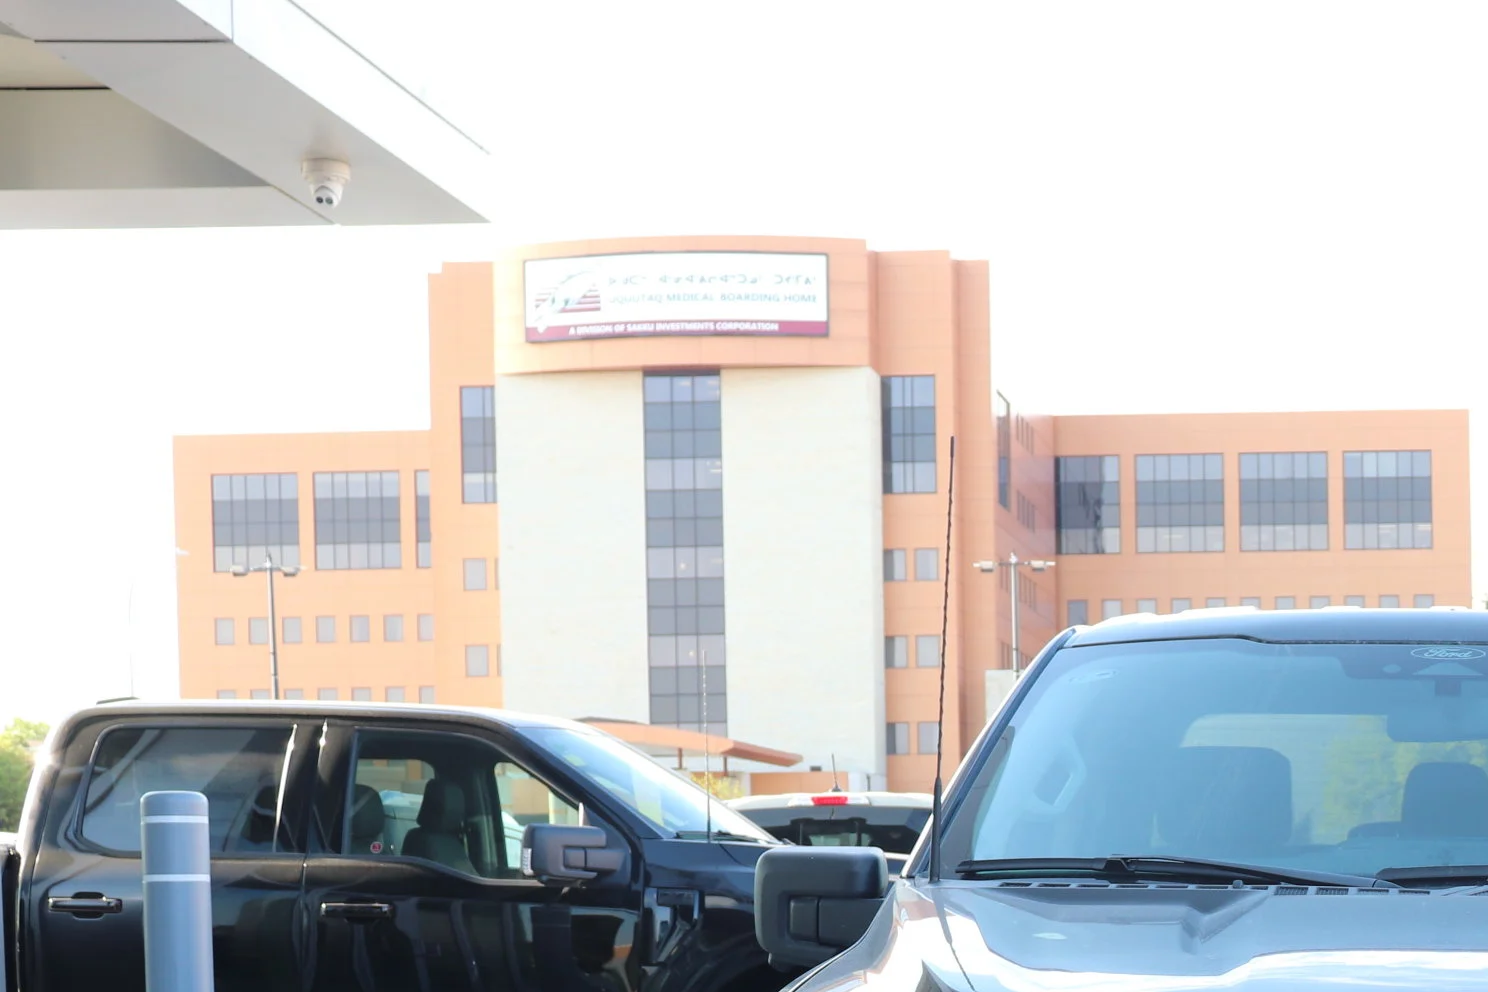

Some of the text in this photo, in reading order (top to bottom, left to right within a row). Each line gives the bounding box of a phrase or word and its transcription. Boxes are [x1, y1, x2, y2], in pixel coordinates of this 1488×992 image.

[666, 292, 715, 303] MEDICAL
[719, 292, 781, 303] BOARDING
[783, 292, 818, 304] HOME
[614, 323, 625, 333] OF
[655, 321, 715, 331] INVESTMENTS
[715, 321, 779, 332] CORPORATION
[1423, 646, 1474, 658] Ford
